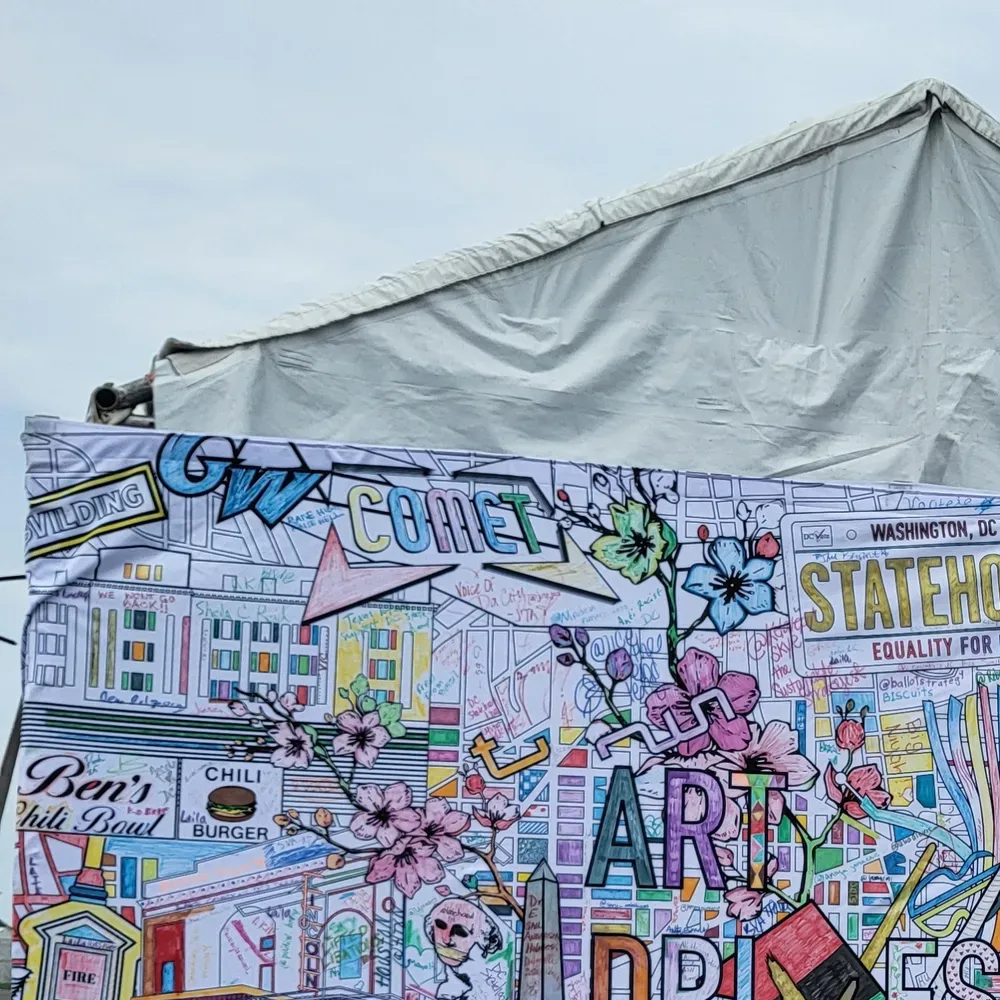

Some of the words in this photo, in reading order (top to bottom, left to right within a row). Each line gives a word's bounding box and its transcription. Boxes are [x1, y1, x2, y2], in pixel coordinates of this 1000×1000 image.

[347, 485, 541, 555] COMET
[870, 520, 974, 542] WASHINGTON,
[978, 519, 997, 537] DC
[872, 637, 953, 661] EQUALITY
[960, 634, 992, 656] FOR
[18, 754, 153, 804] Ben's
[205, 766, 261, 784] CHILI
[74, 806, 164, 836] Bowl
[193, 824, 269, 840] BURGER
[584, 764, 788, 891] ART
[63, 969, 97, 985] FIRE
